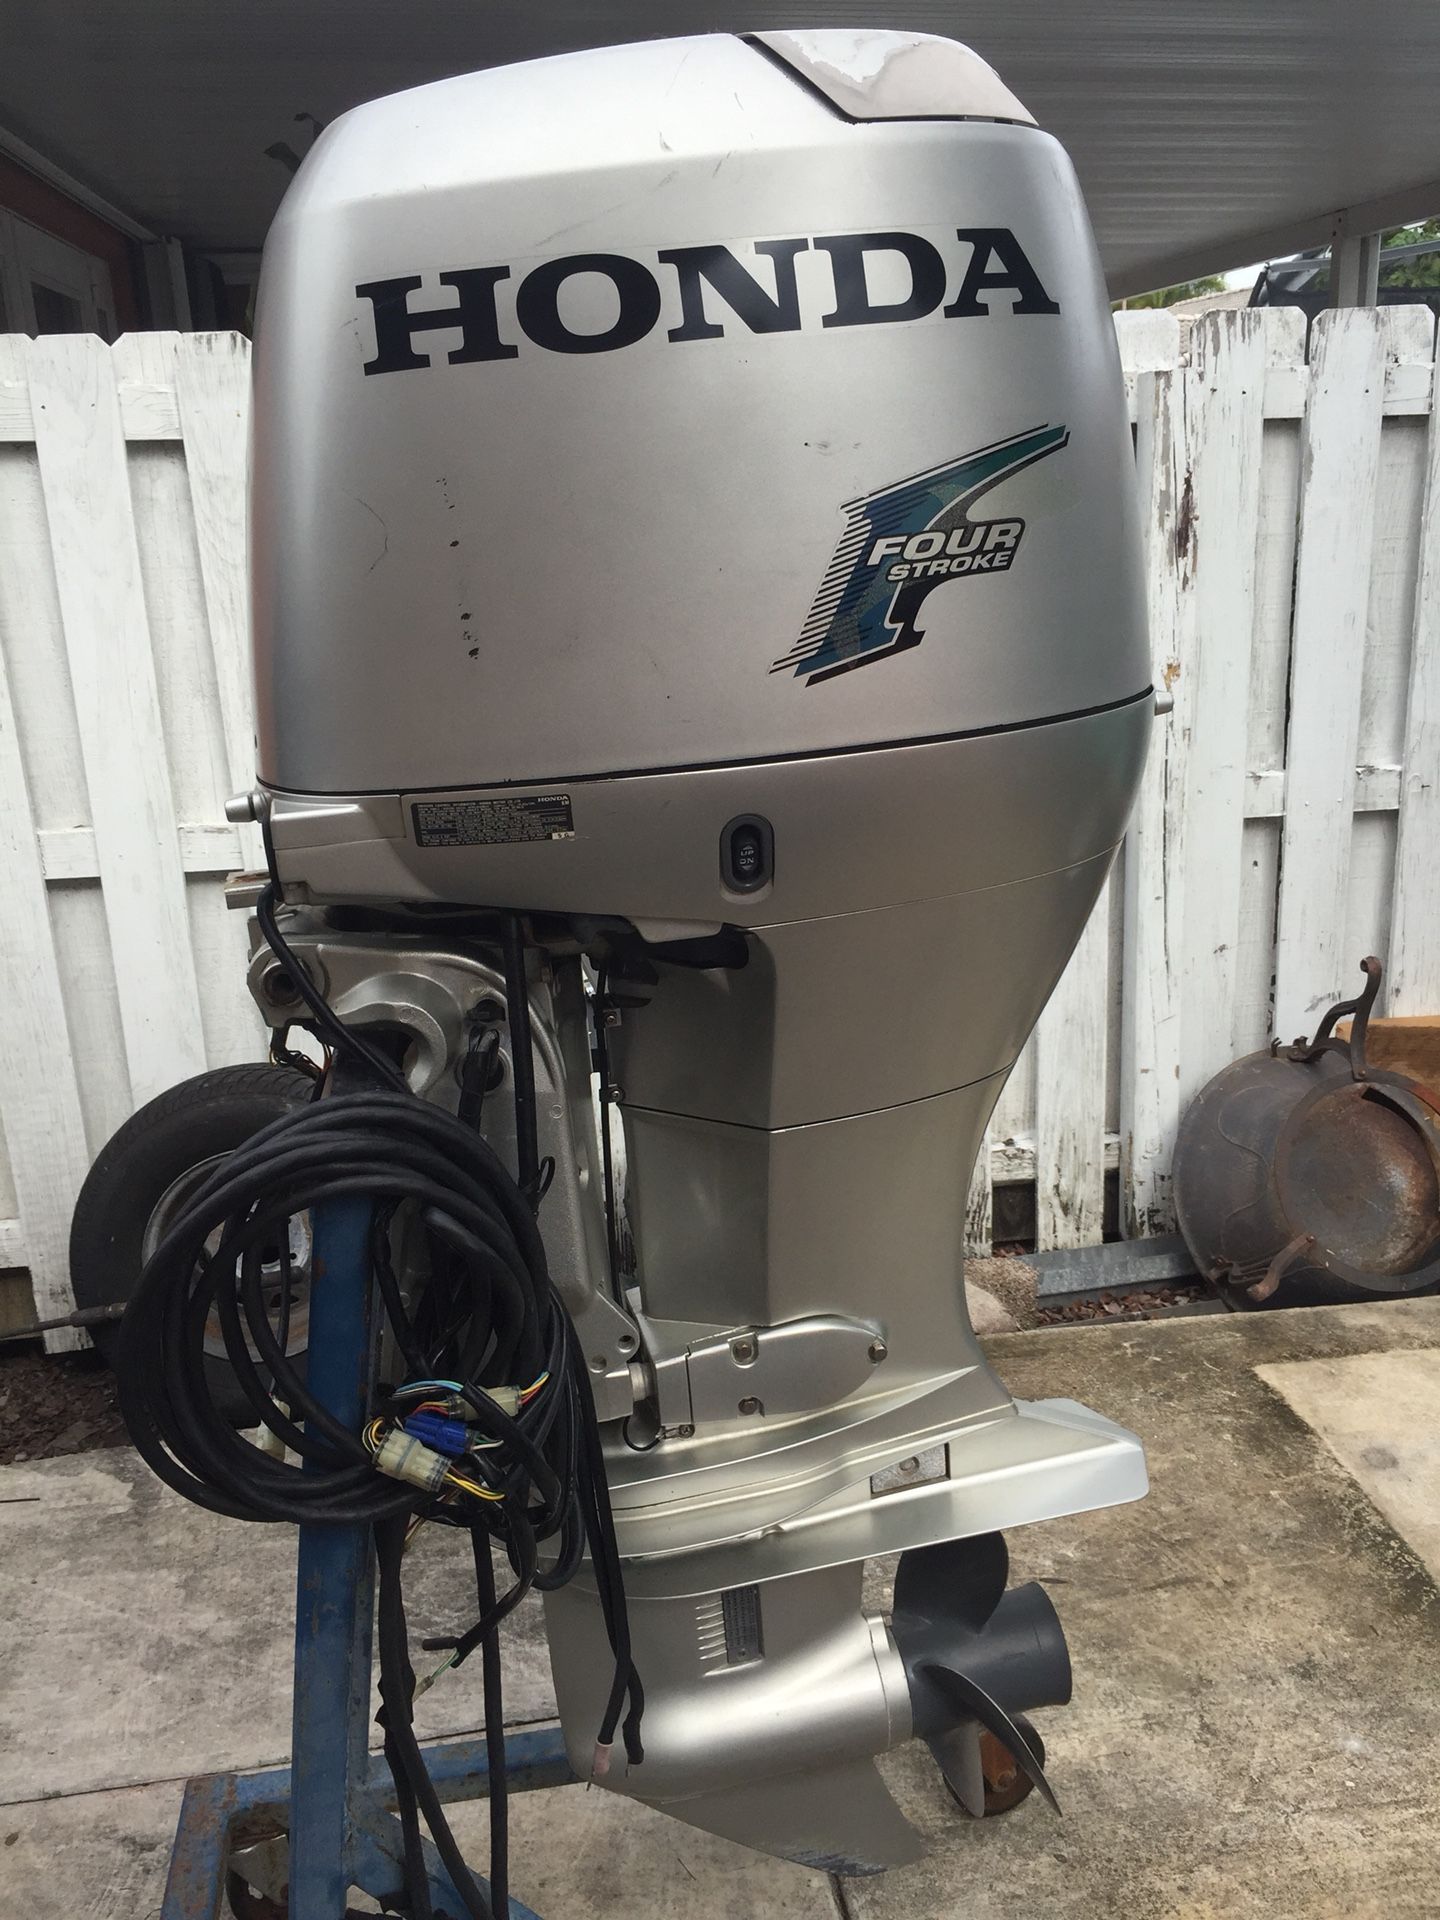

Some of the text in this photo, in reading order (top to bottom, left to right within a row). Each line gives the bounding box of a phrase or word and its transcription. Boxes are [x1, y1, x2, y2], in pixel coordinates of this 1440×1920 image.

[356, 228, 1059, 376] HONDA
[867, 523, 1017, 566] FOUR
[887, 551, 1012, 582] STROKE
[537, 795, 569, 803] HONDA
